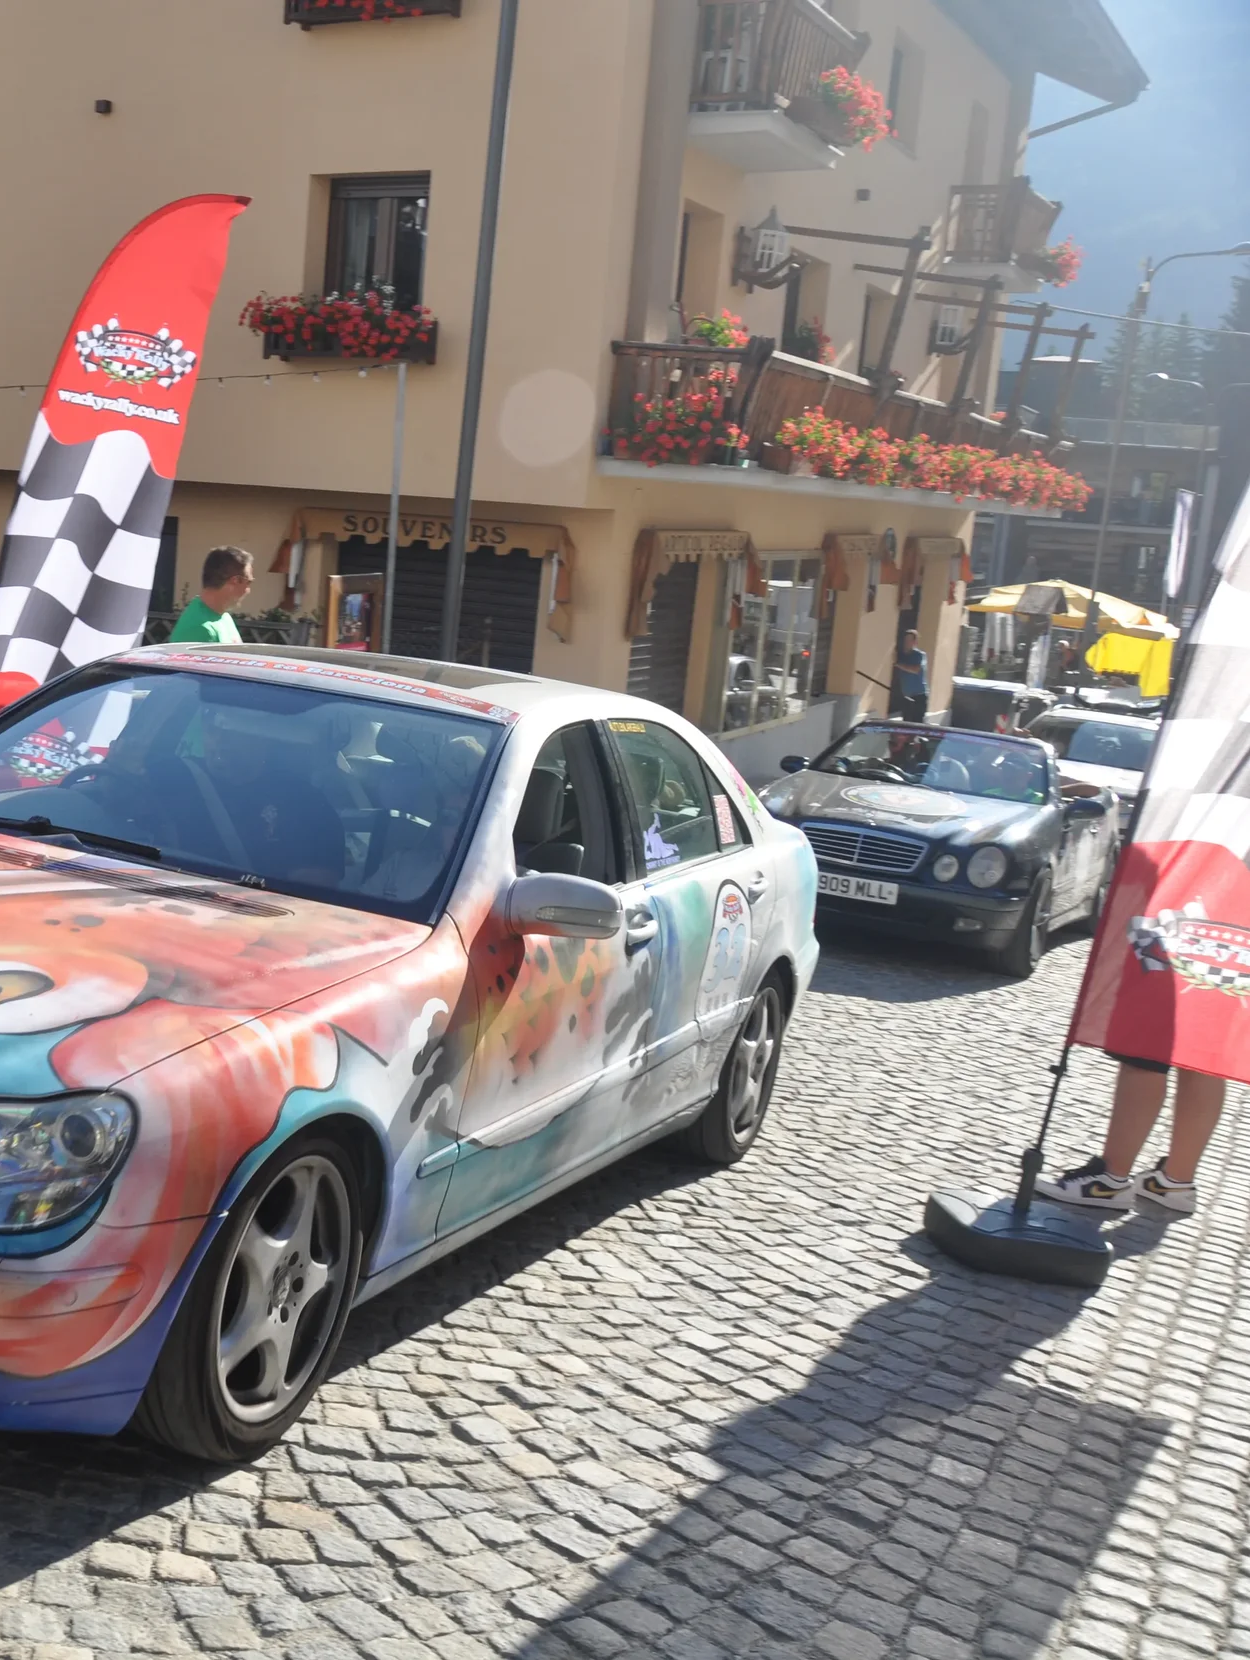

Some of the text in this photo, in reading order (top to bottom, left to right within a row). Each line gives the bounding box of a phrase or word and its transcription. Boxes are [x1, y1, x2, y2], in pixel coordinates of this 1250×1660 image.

[57, 389, 180, 425] wackyrally.co.uk
[342, 514, 507, 545] SOVENRS
[273, 661, 298, 672] to
[304, 666, 427, 695] Barcelona
